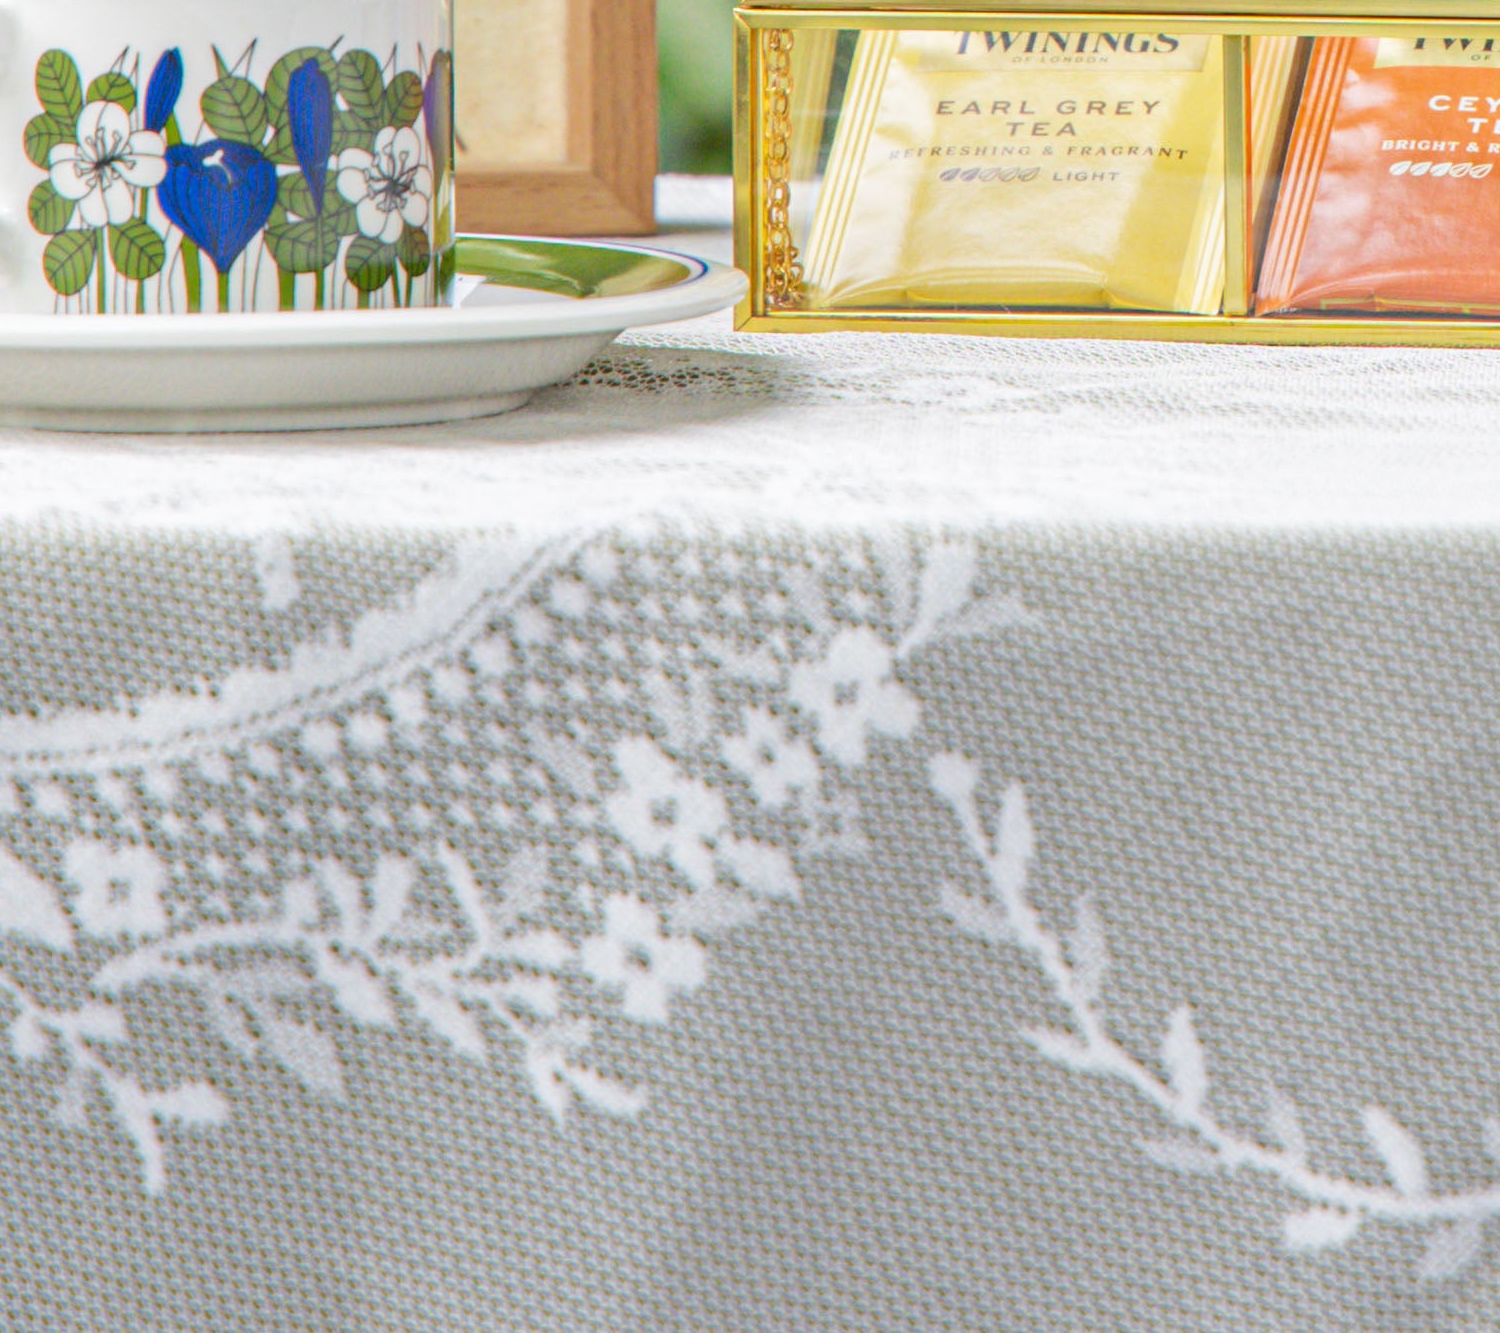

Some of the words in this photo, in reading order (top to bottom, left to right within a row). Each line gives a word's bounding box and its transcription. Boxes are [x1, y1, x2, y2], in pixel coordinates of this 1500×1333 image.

[1040, 55, 1109, 64] LONDON
[1470, 54, 1491, 63] OF
[935, 100, 1037, 116] EARL
[1056, 99, 1162, 116] GREY
[1005, 121, 1077, 137] TEA
[888, 145, 1031, 160] REFRESHING
[1042, 145, 1054, 157] &
[1067, 145, 1189, 161] FRAGRANT
[1381, 138, 1460, 153] BRIGHT
[1466, 141, 1480, 153] &
[1052, 171, 1121, 183] LIGHT
